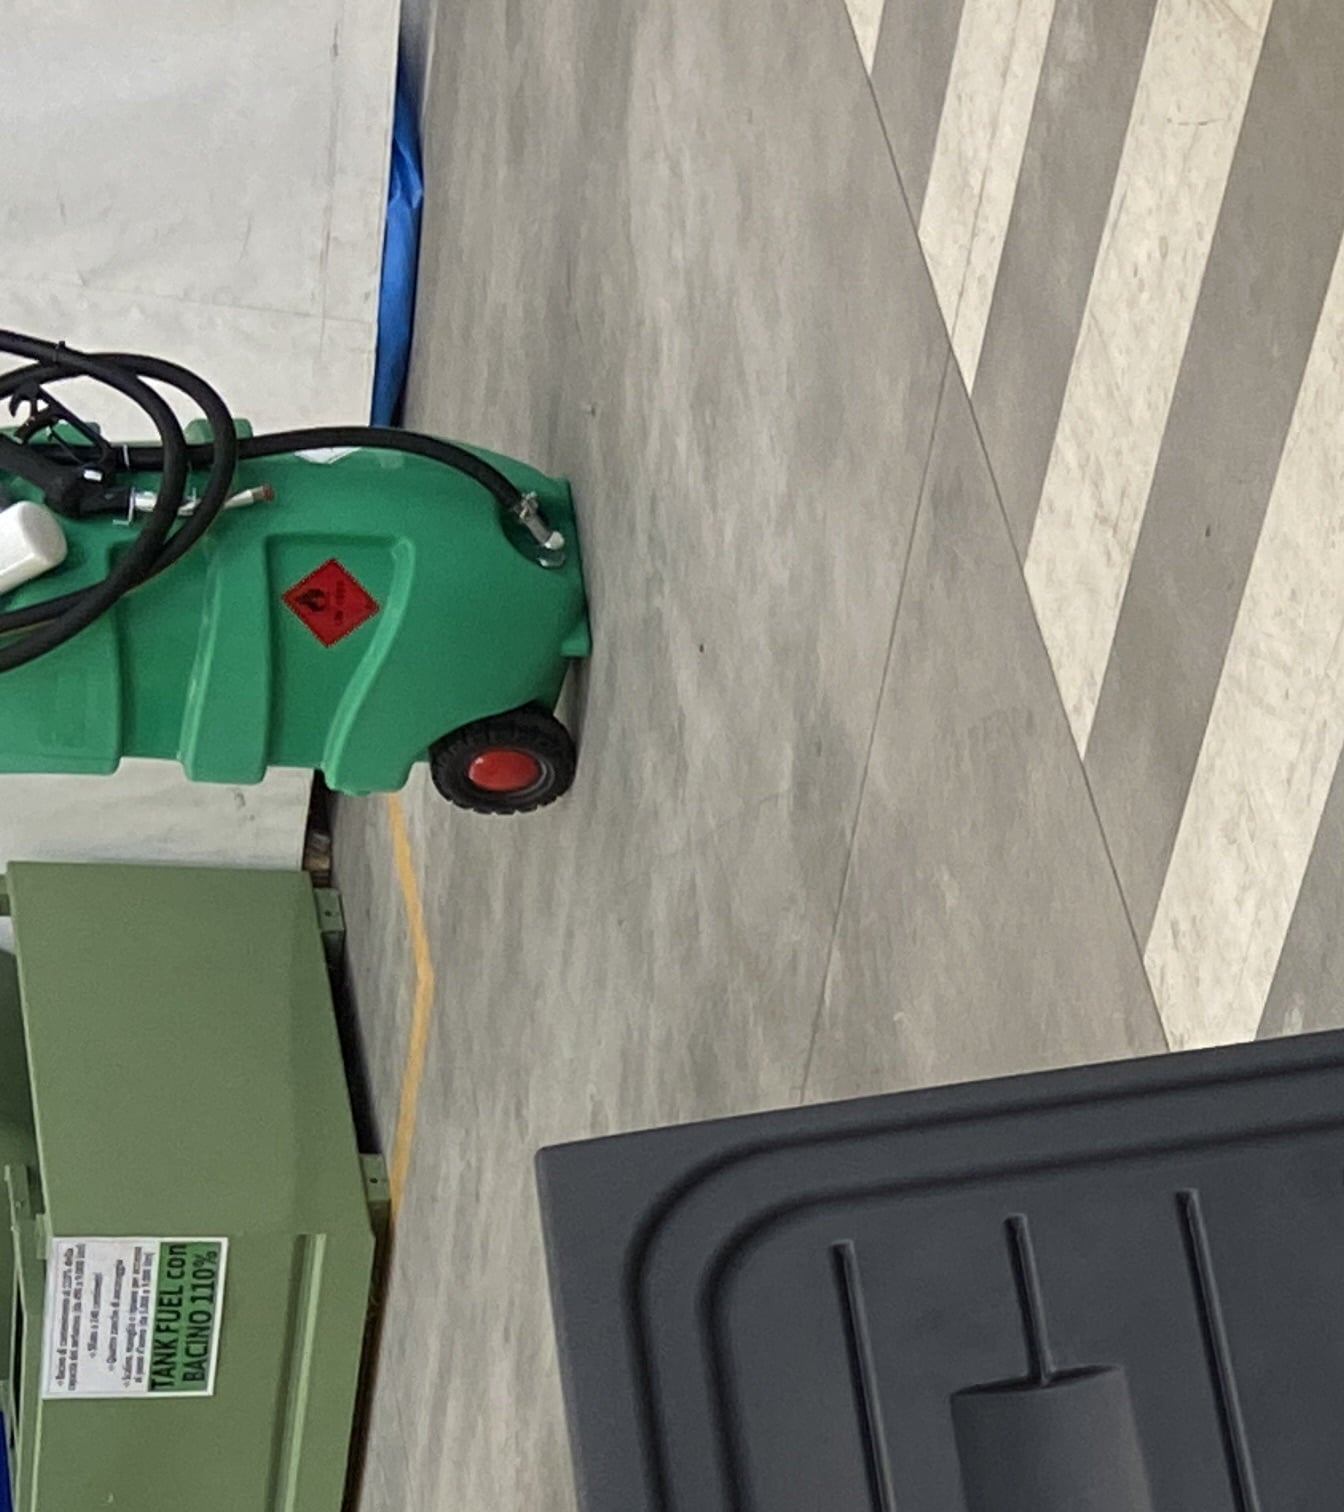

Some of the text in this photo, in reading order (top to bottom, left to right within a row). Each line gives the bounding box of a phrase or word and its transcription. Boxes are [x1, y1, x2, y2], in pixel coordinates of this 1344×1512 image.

[150, 1244, 187, 1390] TANK FUEL con
[183, 1250, 218, 1382] BACINO 110%
